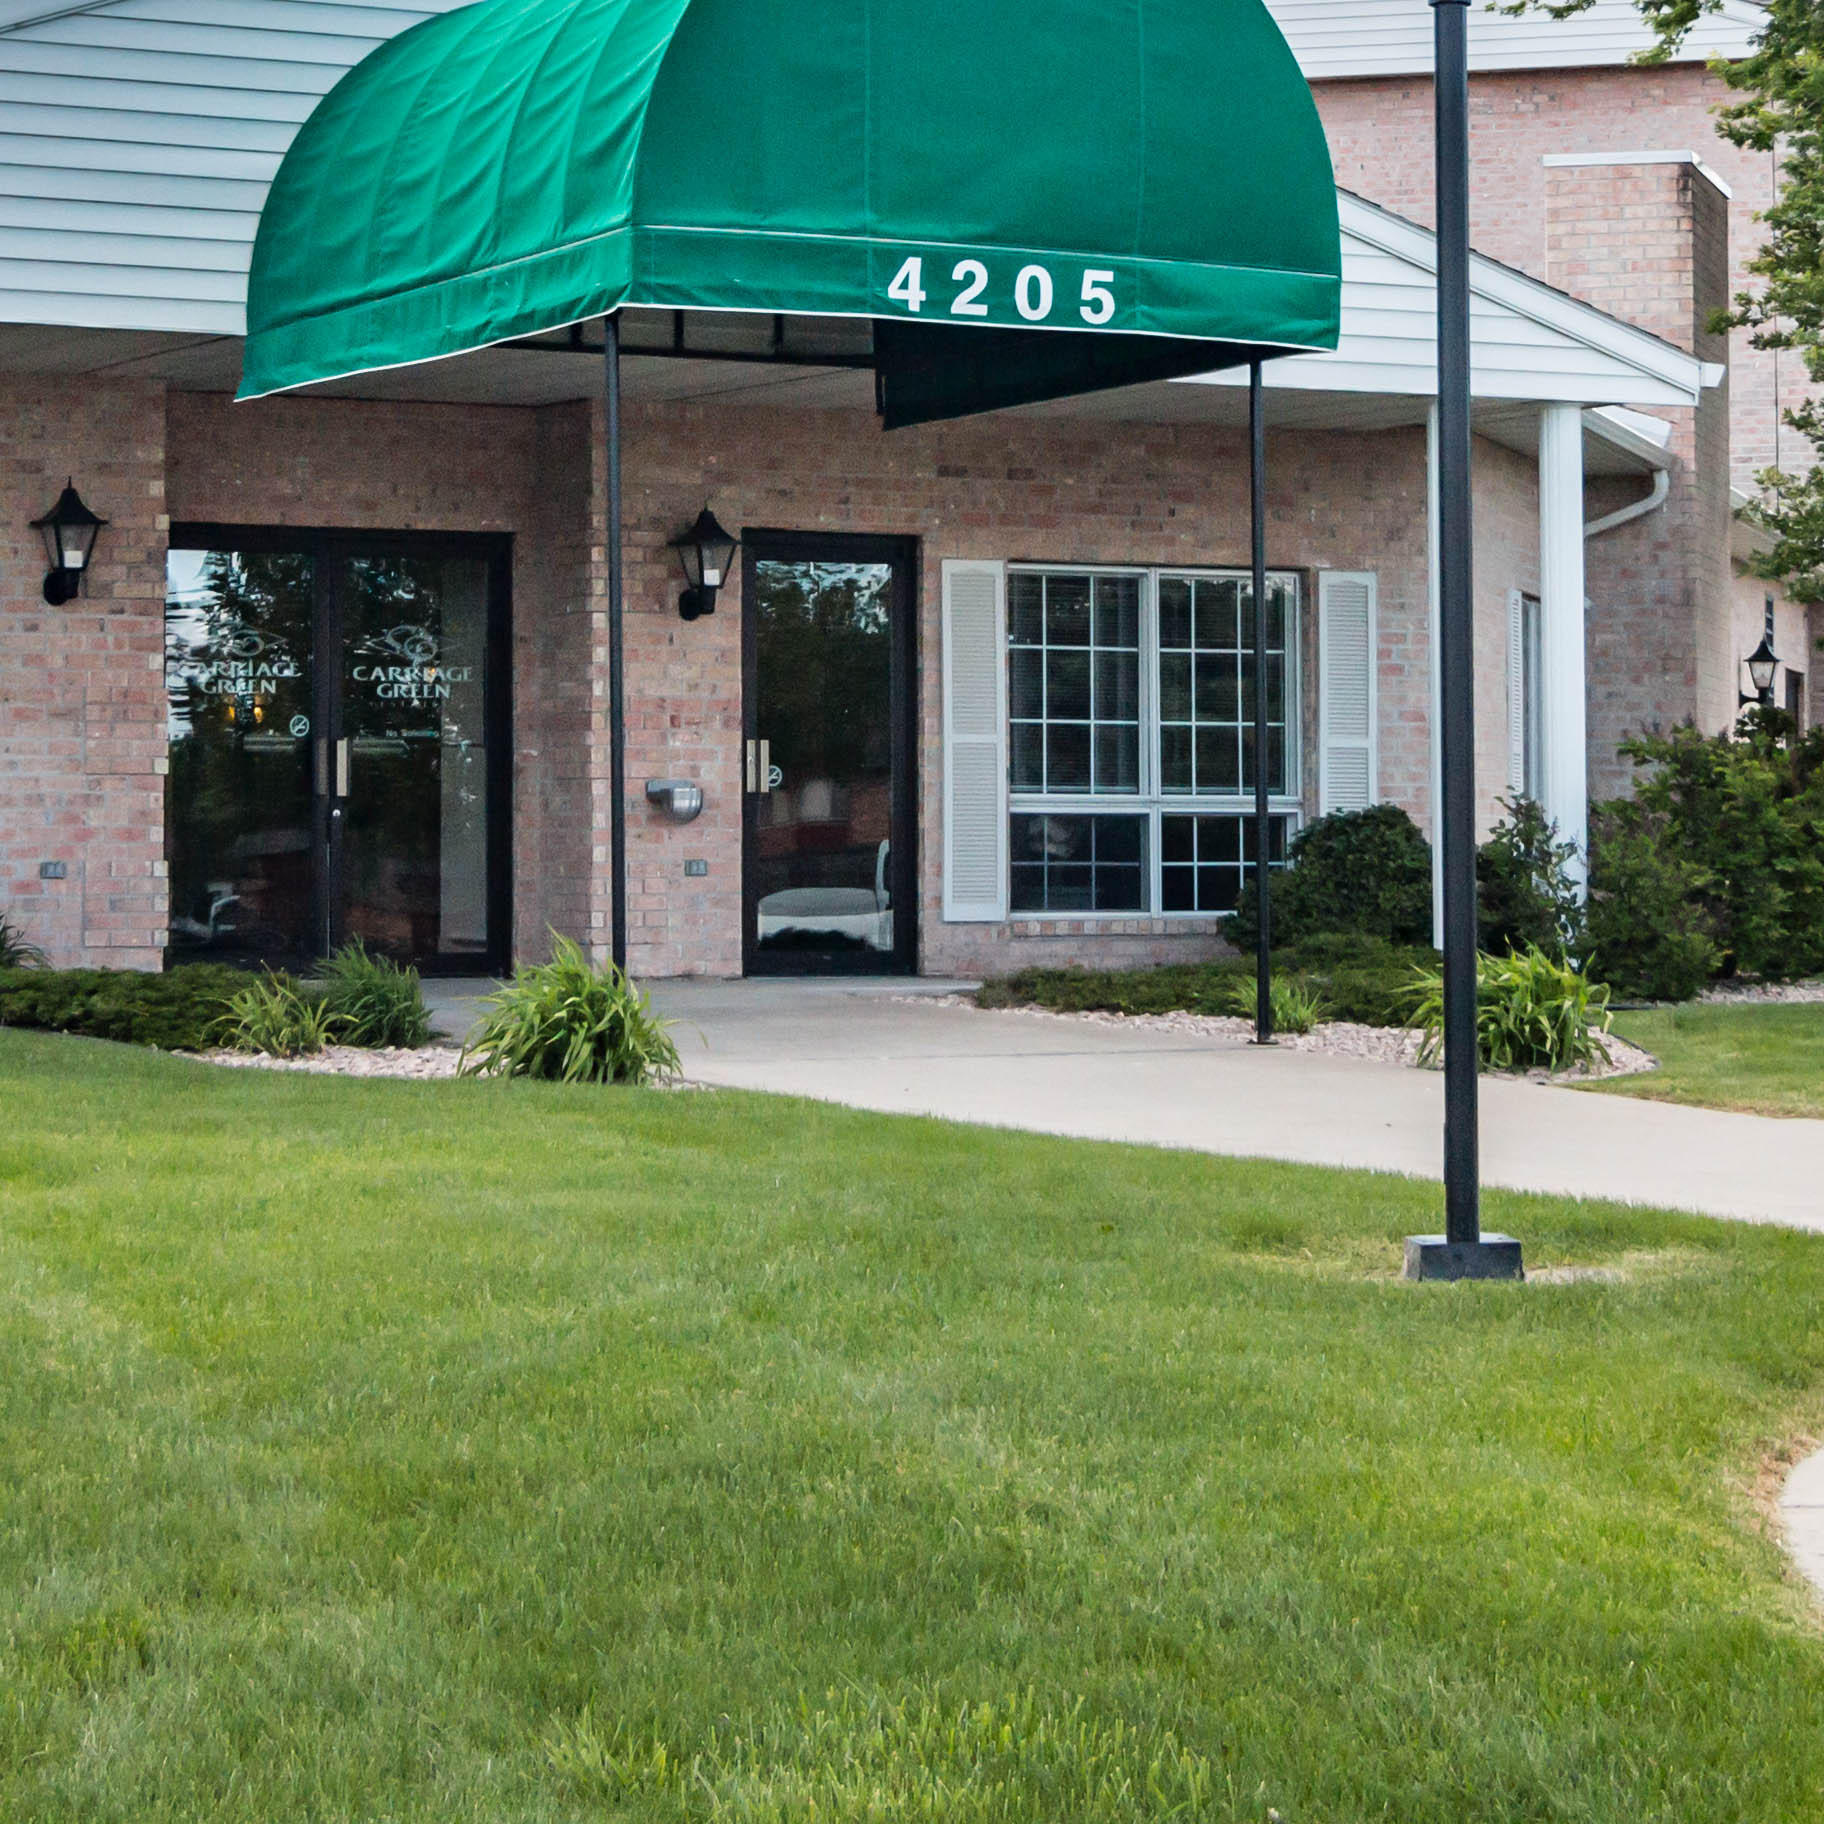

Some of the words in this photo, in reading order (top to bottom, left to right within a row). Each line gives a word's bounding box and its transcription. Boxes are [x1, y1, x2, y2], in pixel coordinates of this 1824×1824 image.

[887, 256, 1116, 325] 4205
[352, 665, 473, 682] CARRIAGE
[200, 678, 277, 695] GREEN
[376, 682, 451, 699] GREEN
